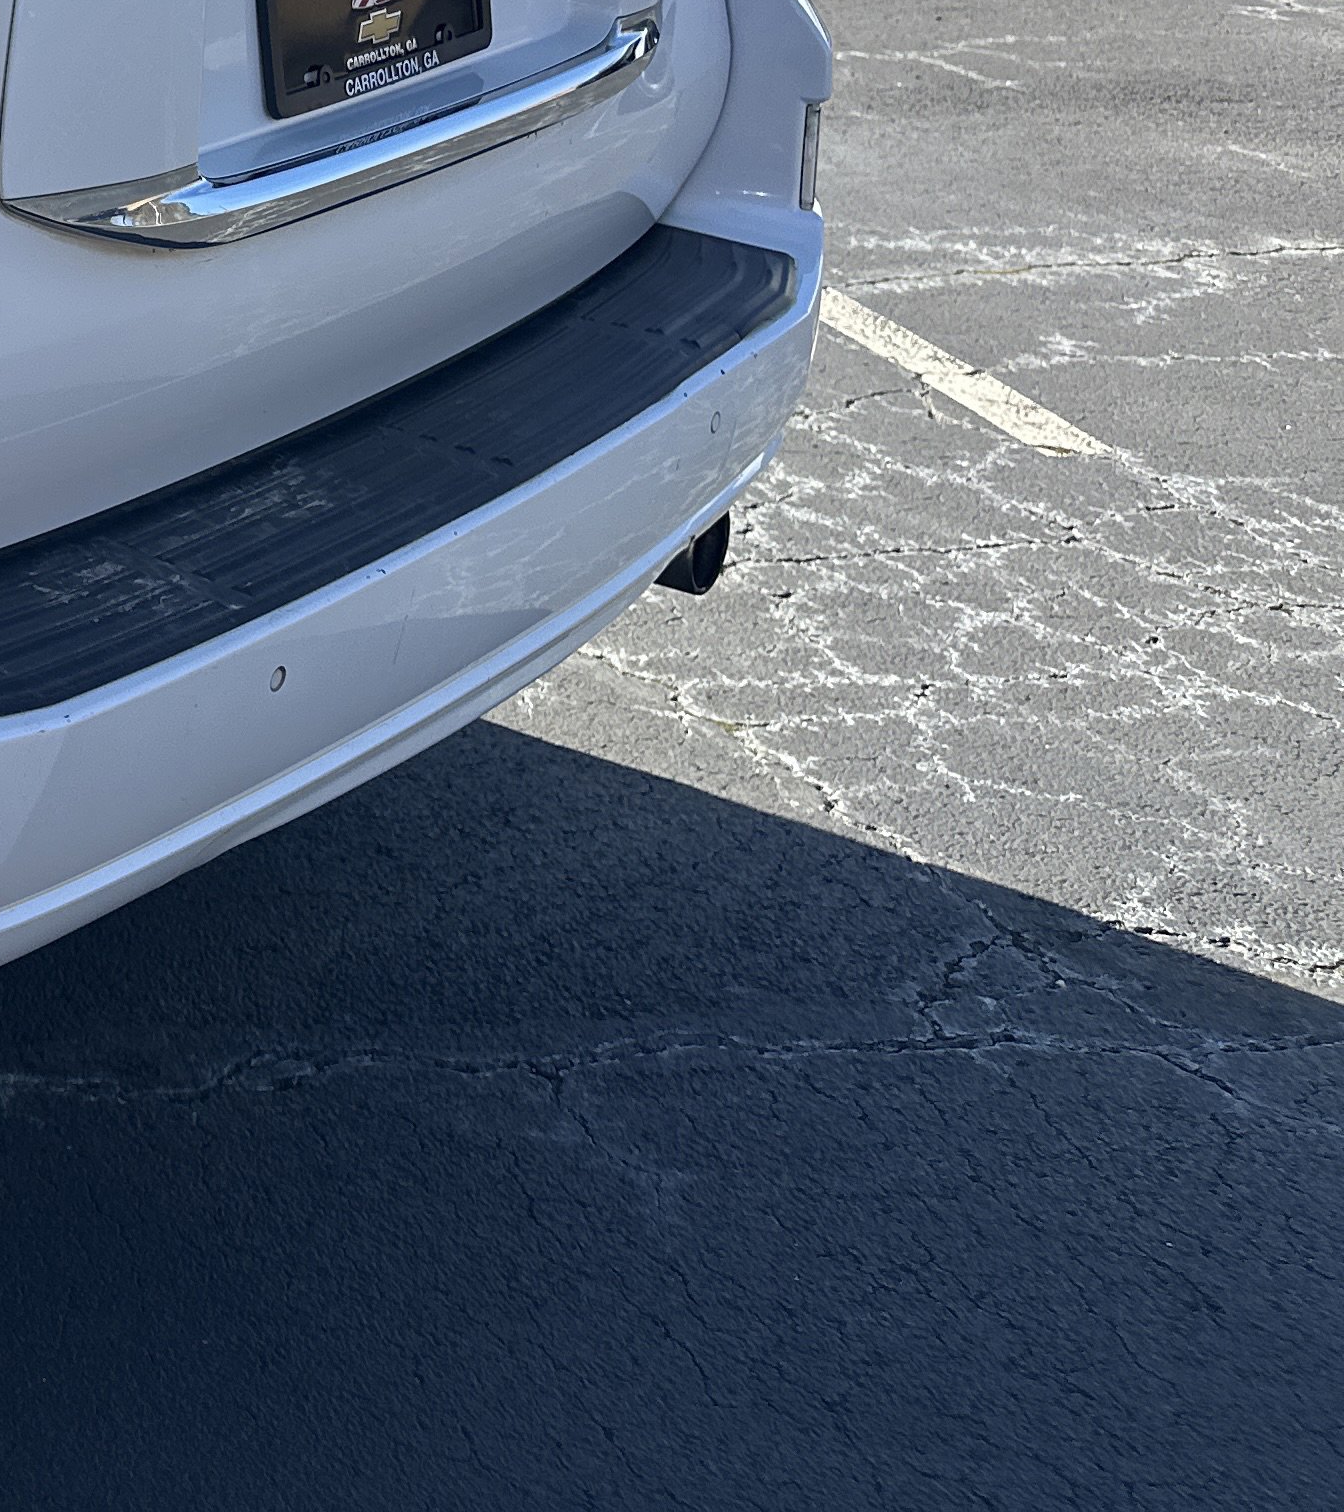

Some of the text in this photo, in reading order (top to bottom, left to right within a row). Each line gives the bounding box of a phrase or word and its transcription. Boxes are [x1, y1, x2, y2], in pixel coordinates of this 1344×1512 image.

[345, 49, 440, 97] CARROLLTON, GA
[346, 42, 405, 71] CARROLLTON,
